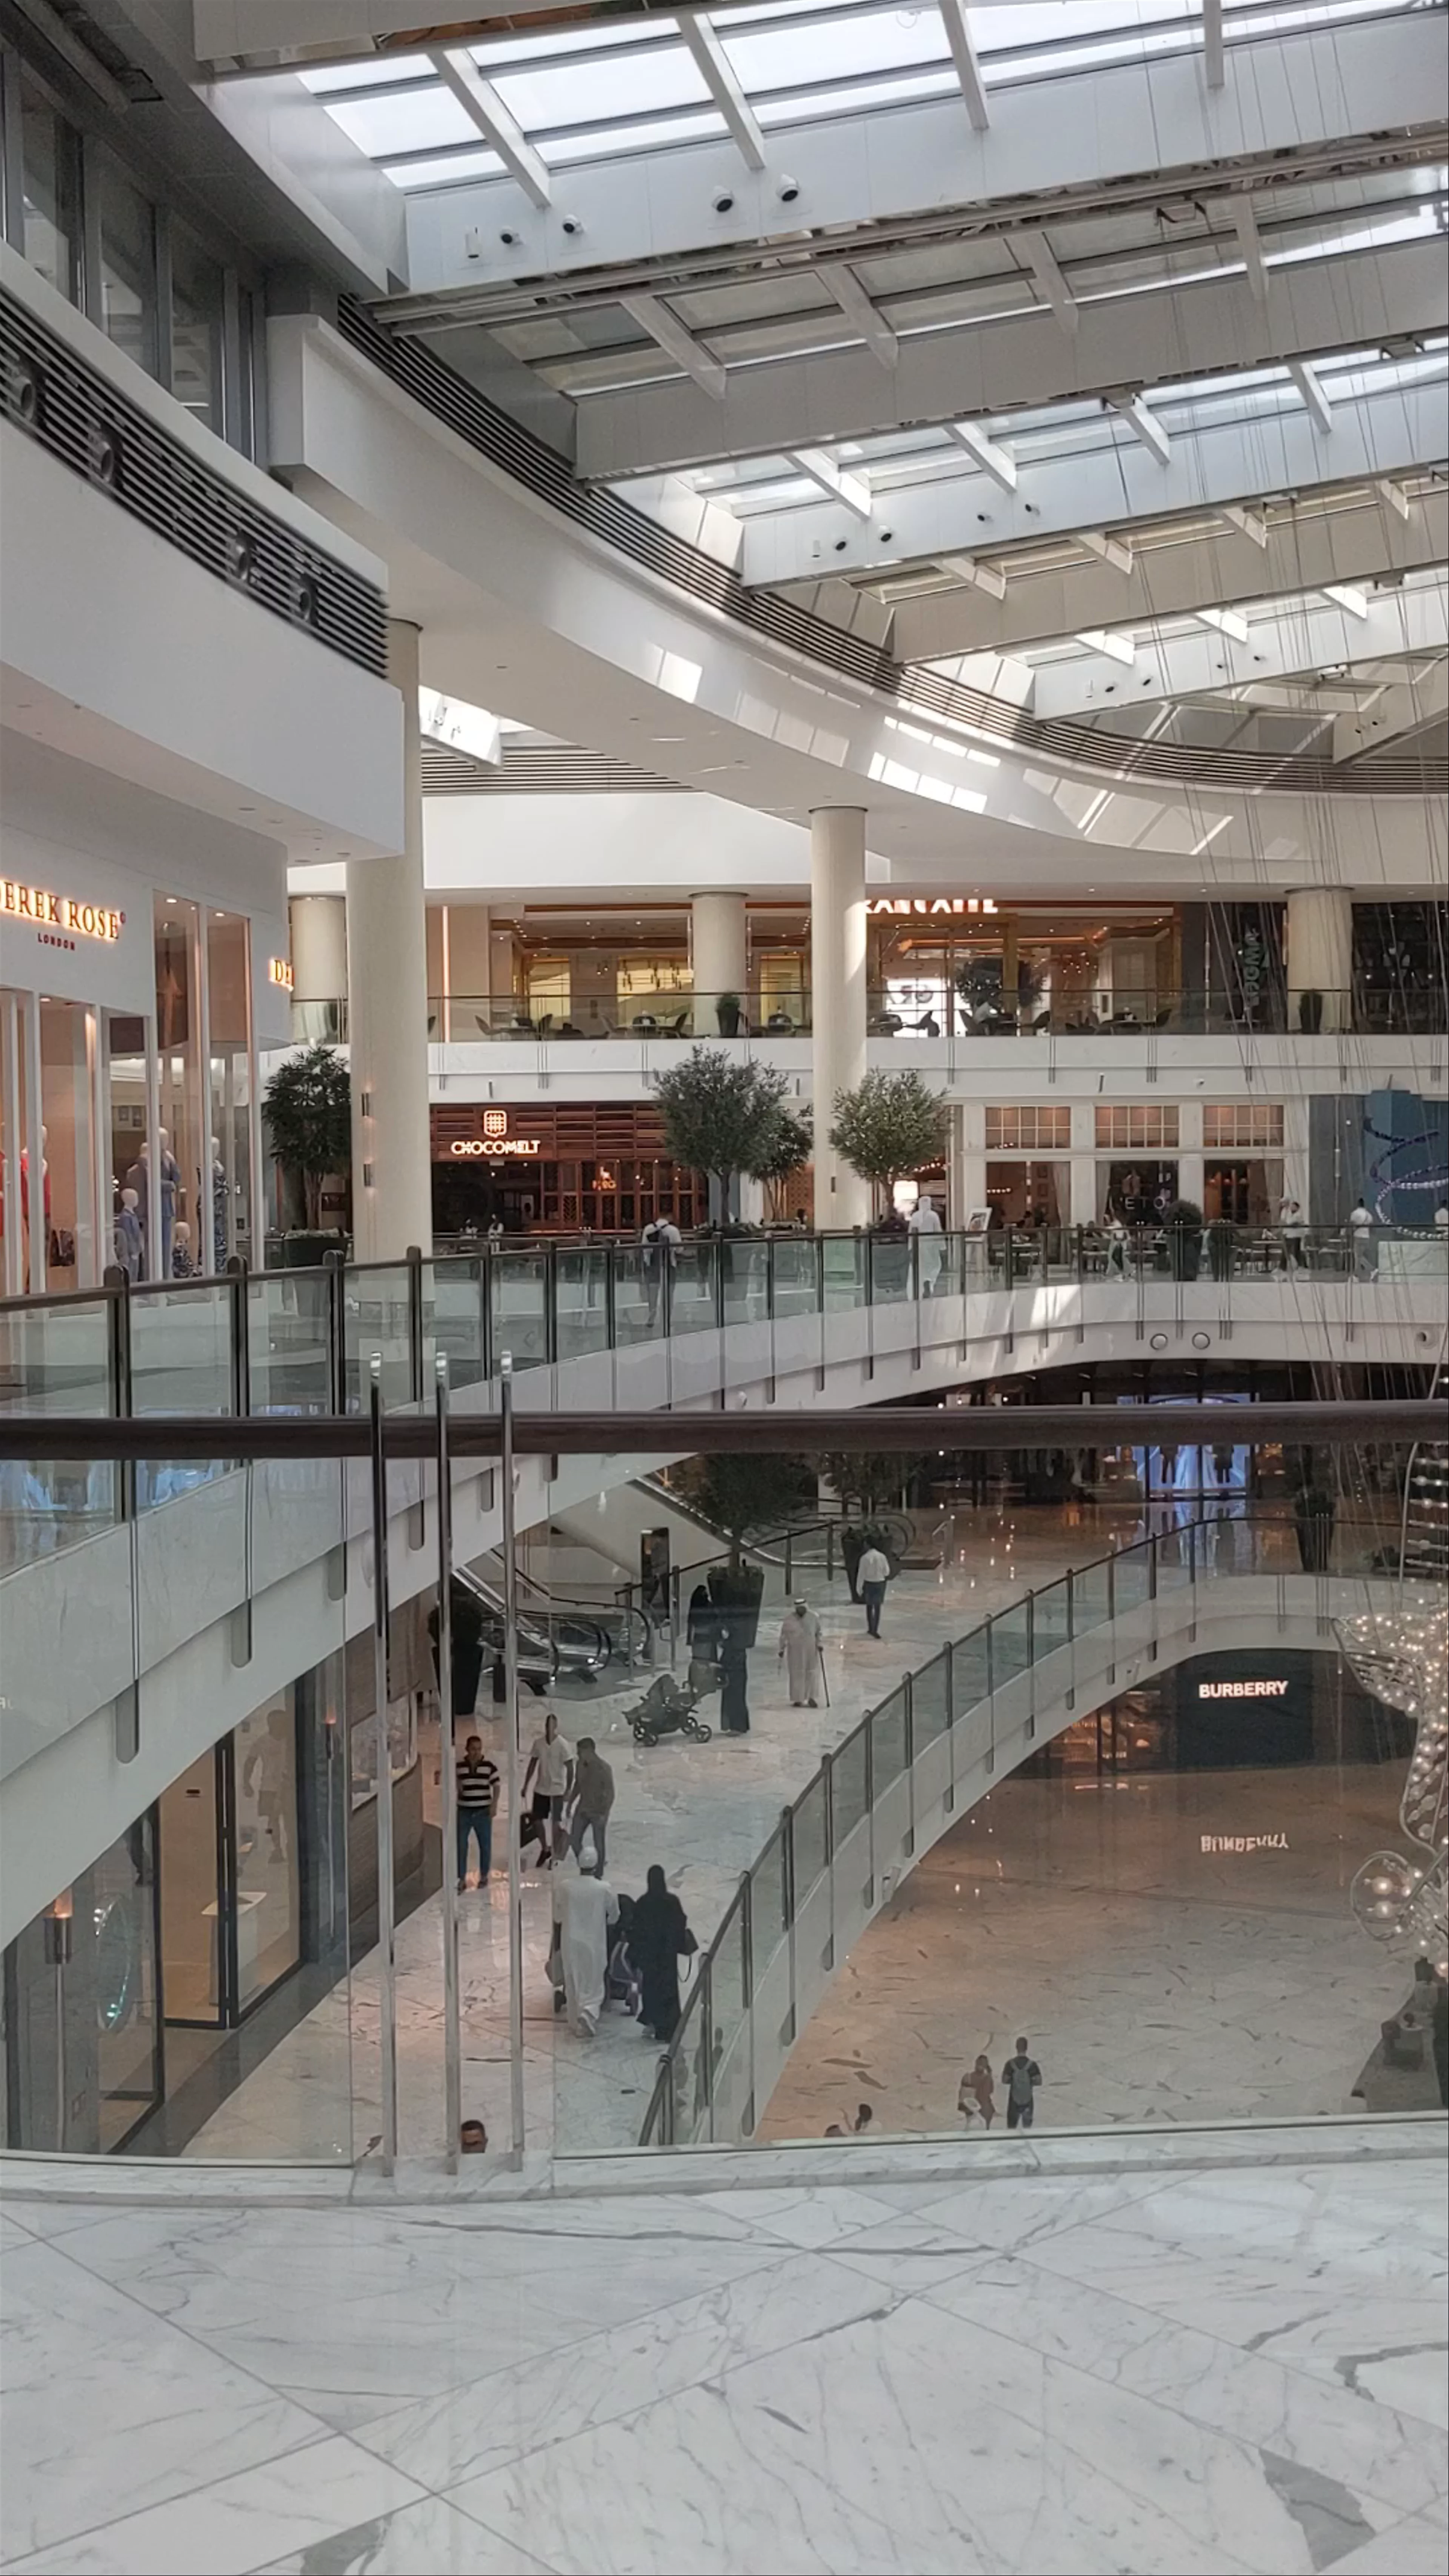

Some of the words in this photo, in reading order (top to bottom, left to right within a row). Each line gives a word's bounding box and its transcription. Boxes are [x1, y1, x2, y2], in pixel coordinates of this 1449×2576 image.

[0, 881, 60, 923] EREK
[68, 901, 119, 939] ROSE
[38, 933, 75, 950] LONDON
[451, 1140, 541, 1155] CHOCOMELT
[1198, 1680, 1289, 1699] BURBERRY
